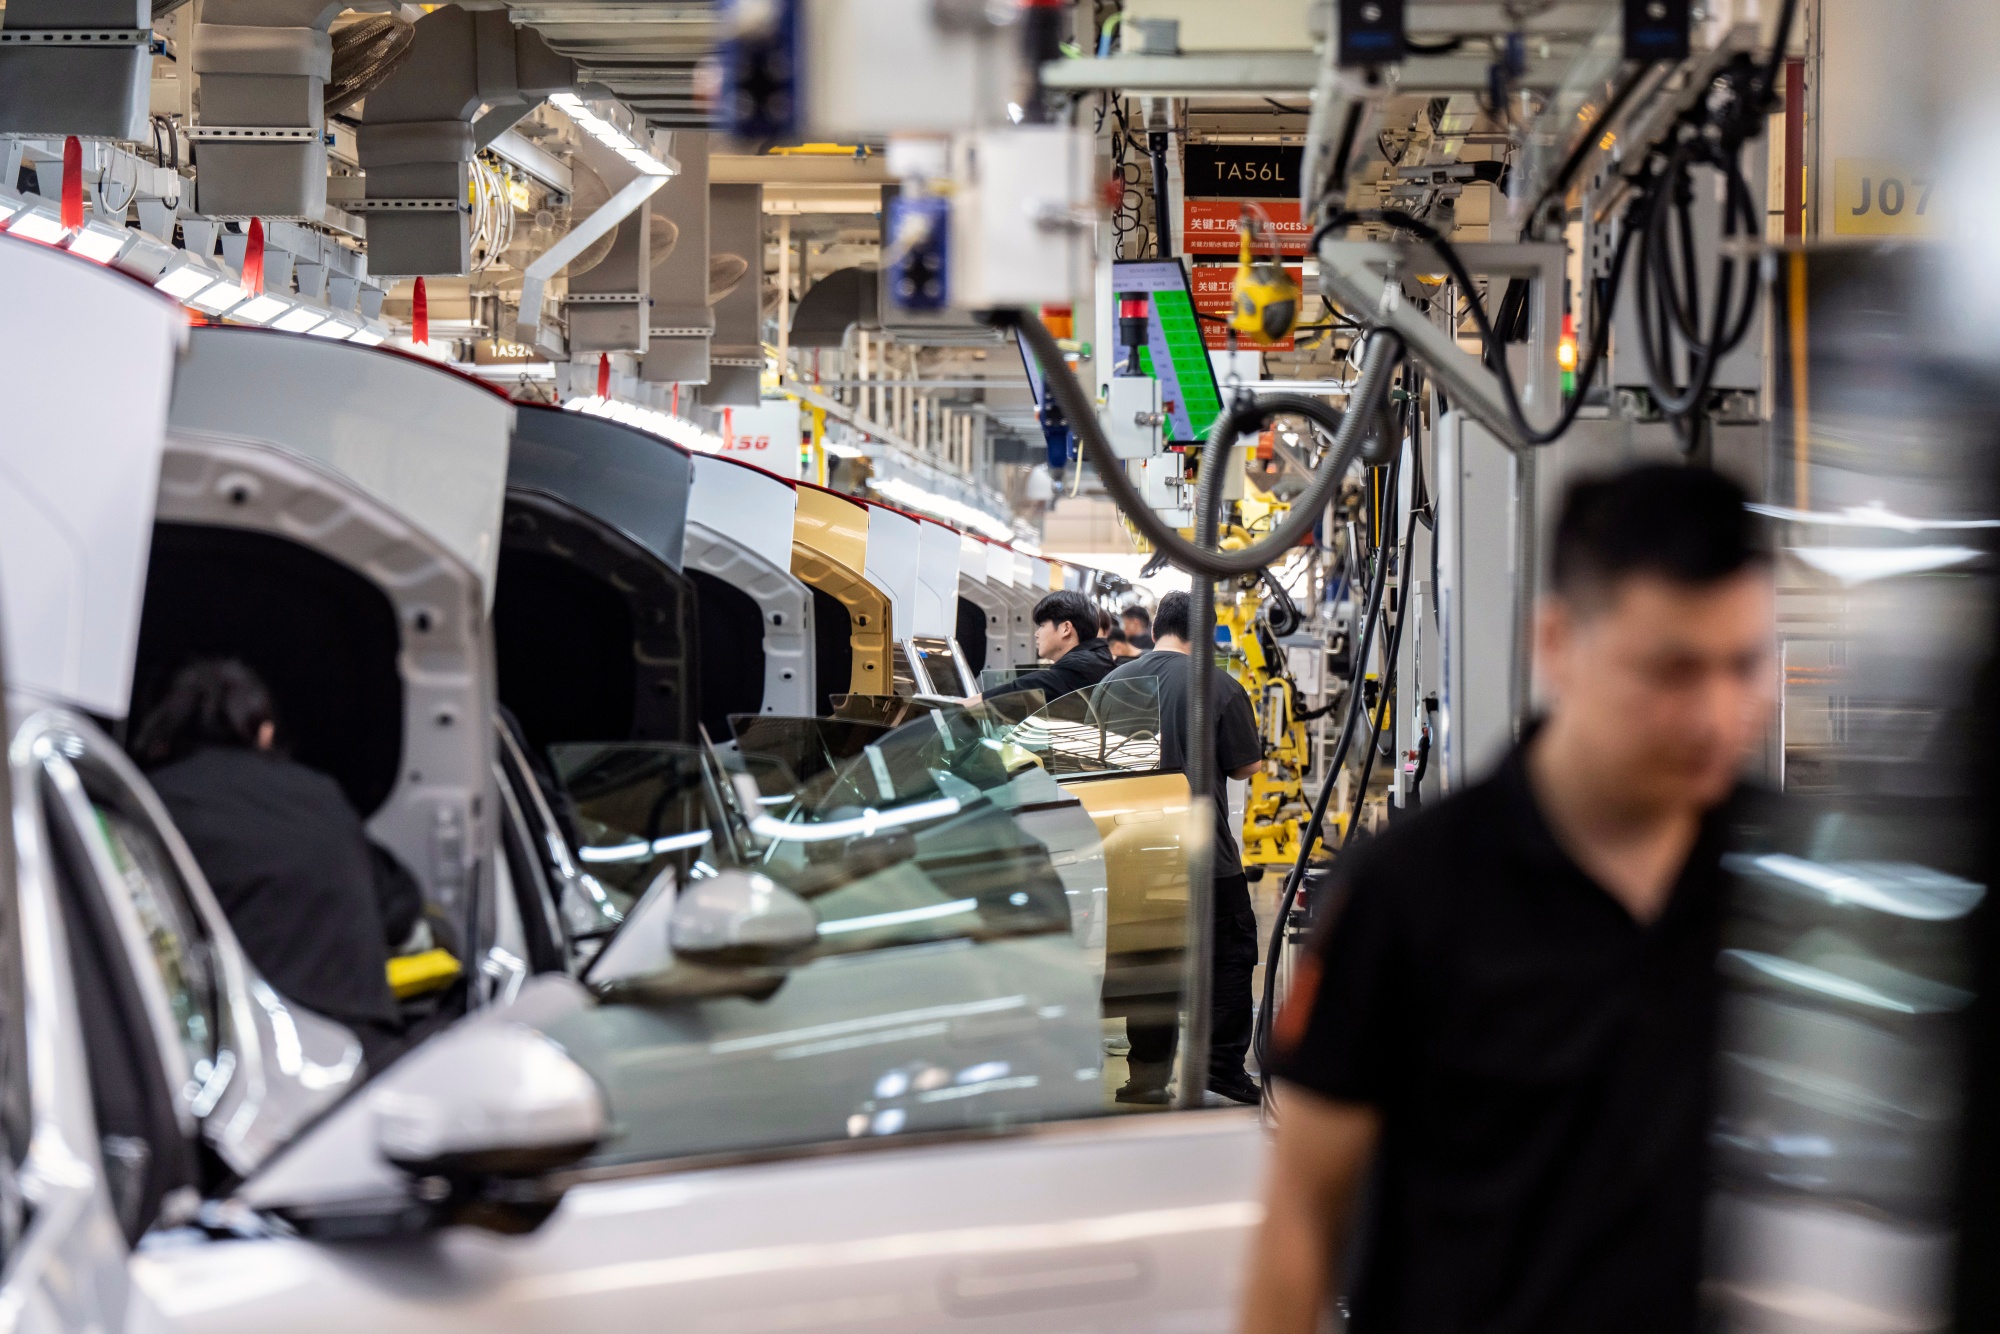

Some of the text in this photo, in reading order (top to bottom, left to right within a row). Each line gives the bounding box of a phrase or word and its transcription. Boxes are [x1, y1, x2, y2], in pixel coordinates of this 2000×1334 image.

[1214, 161, 1286, 181] TA56L
[1851, 177, 1938, 216] J07
[1190, 218, 1239, 231] 关键工序
[1263, 221, 1308, 231] PROCESS
